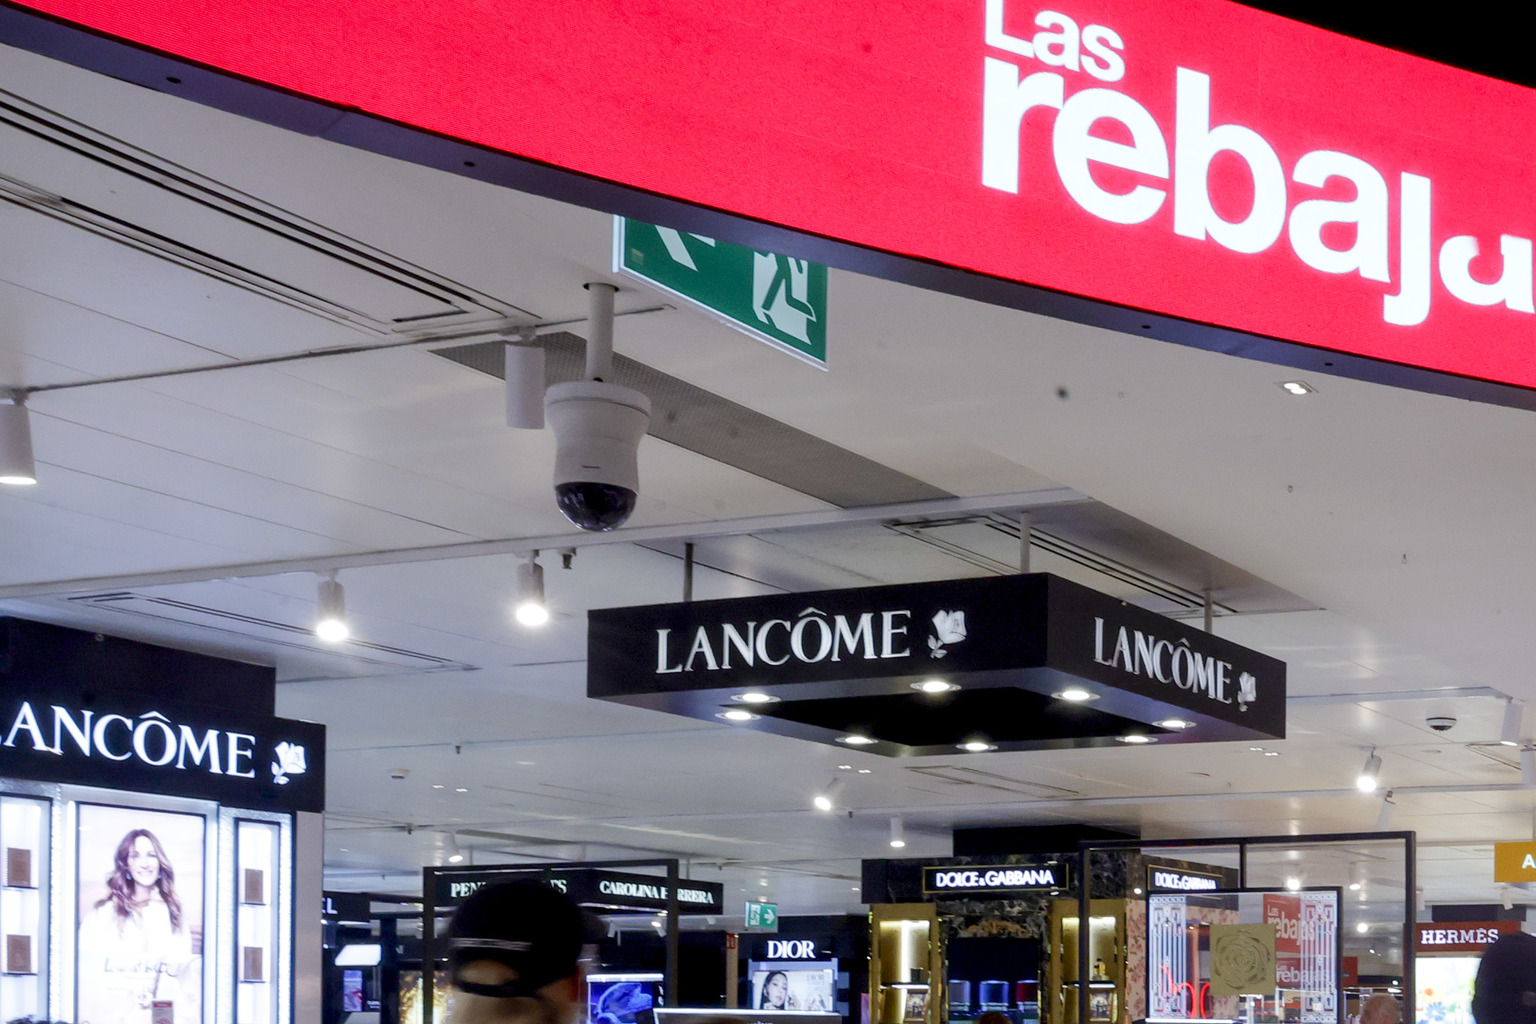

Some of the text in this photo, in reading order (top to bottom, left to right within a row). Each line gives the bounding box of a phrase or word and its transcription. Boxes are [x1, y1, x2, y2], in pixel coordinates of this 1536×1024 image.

[984, 0, 1126, 82] Las
[655, 606, 912, 675] LANCÔME
[1094, 615, 1234, 704] LANCÔME
[0, 700, 257, 780] ANCÔME
[599, 880, 659, 899] CAROLINA
[767, 939, 816, 959] DIOR
